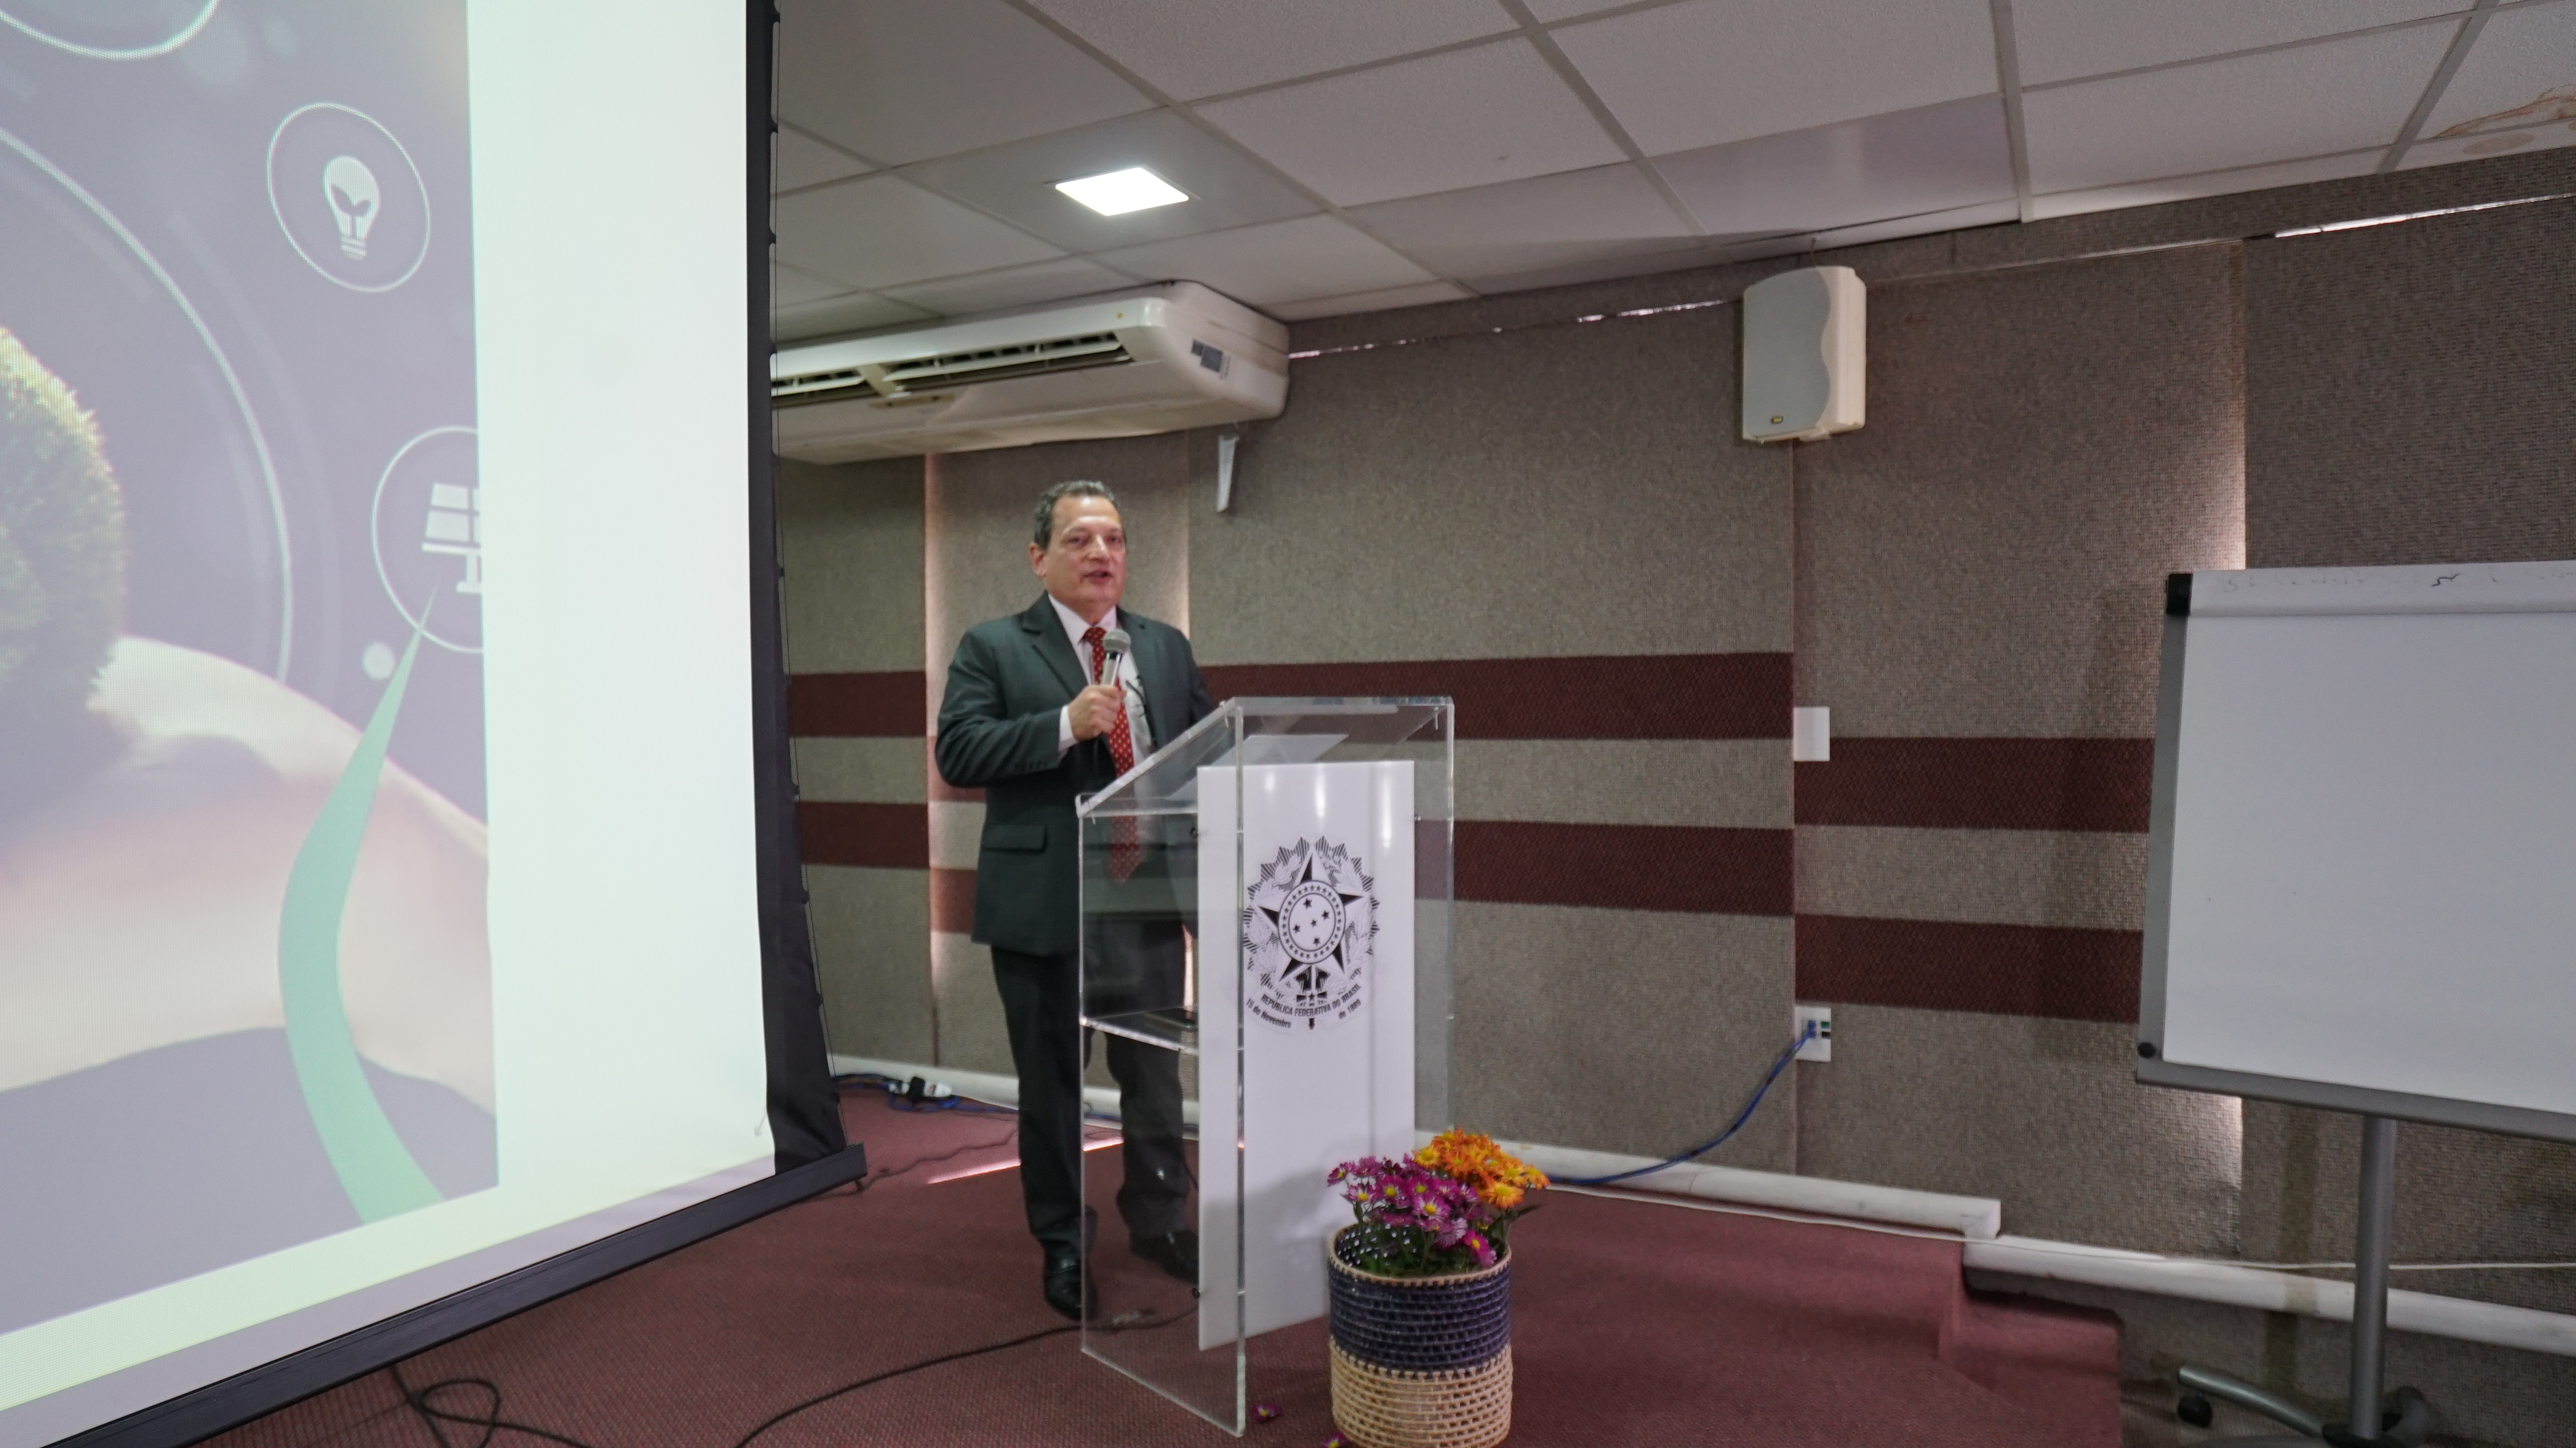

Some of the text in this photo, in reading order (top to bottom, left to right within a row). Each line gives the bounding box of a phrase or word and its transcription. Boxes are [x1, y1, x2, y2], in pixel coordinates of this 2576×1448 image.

[1246, 999, 1362, 1029] 15 de Novembro de 1889
[1294, 1004, 1331, 1017] FEDERATIVA
[1332, 999, 1341, 1009] DO
[1341, 983, 1361, 1003] BRASIL
